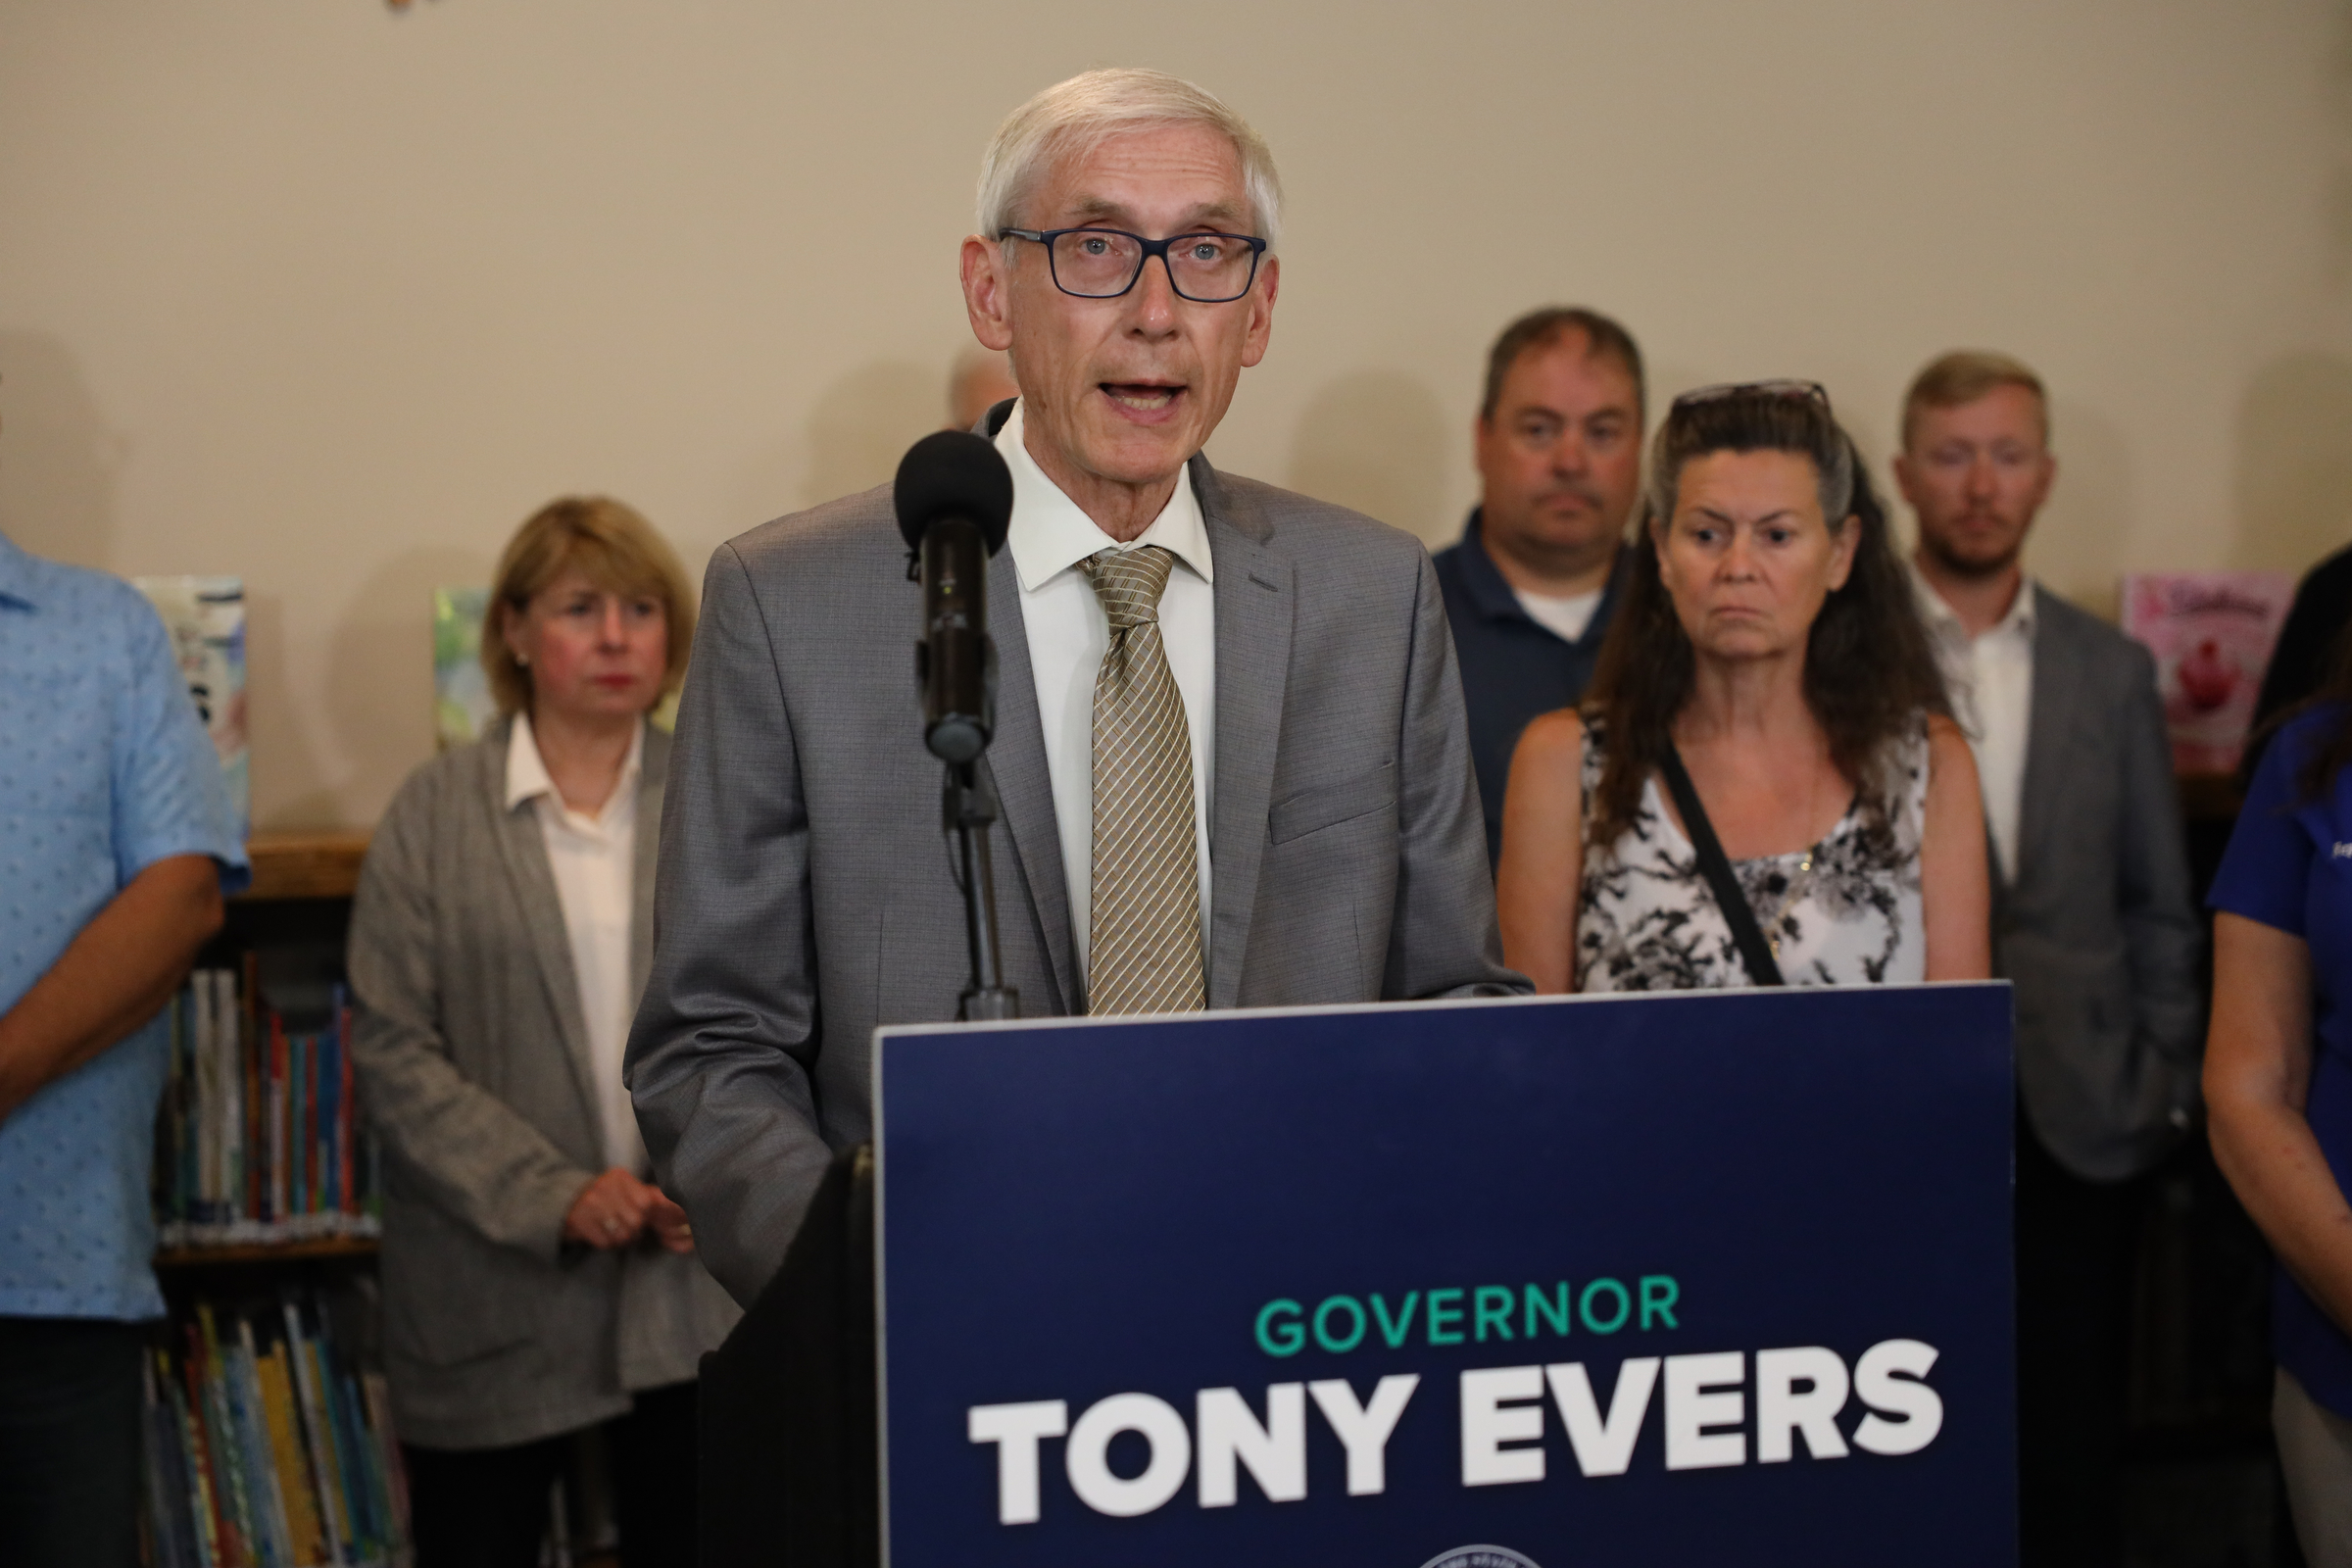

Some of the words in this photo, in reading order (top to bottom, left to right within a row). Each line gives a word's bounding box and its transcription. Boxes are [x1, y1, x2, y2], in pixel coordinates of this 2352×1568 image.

[1254, 1274, 1680, 1357] GOVERNOR
[967, 1373, 1420, 1526] TONY
[1460, 1338, 1944, 1487] EVERS
